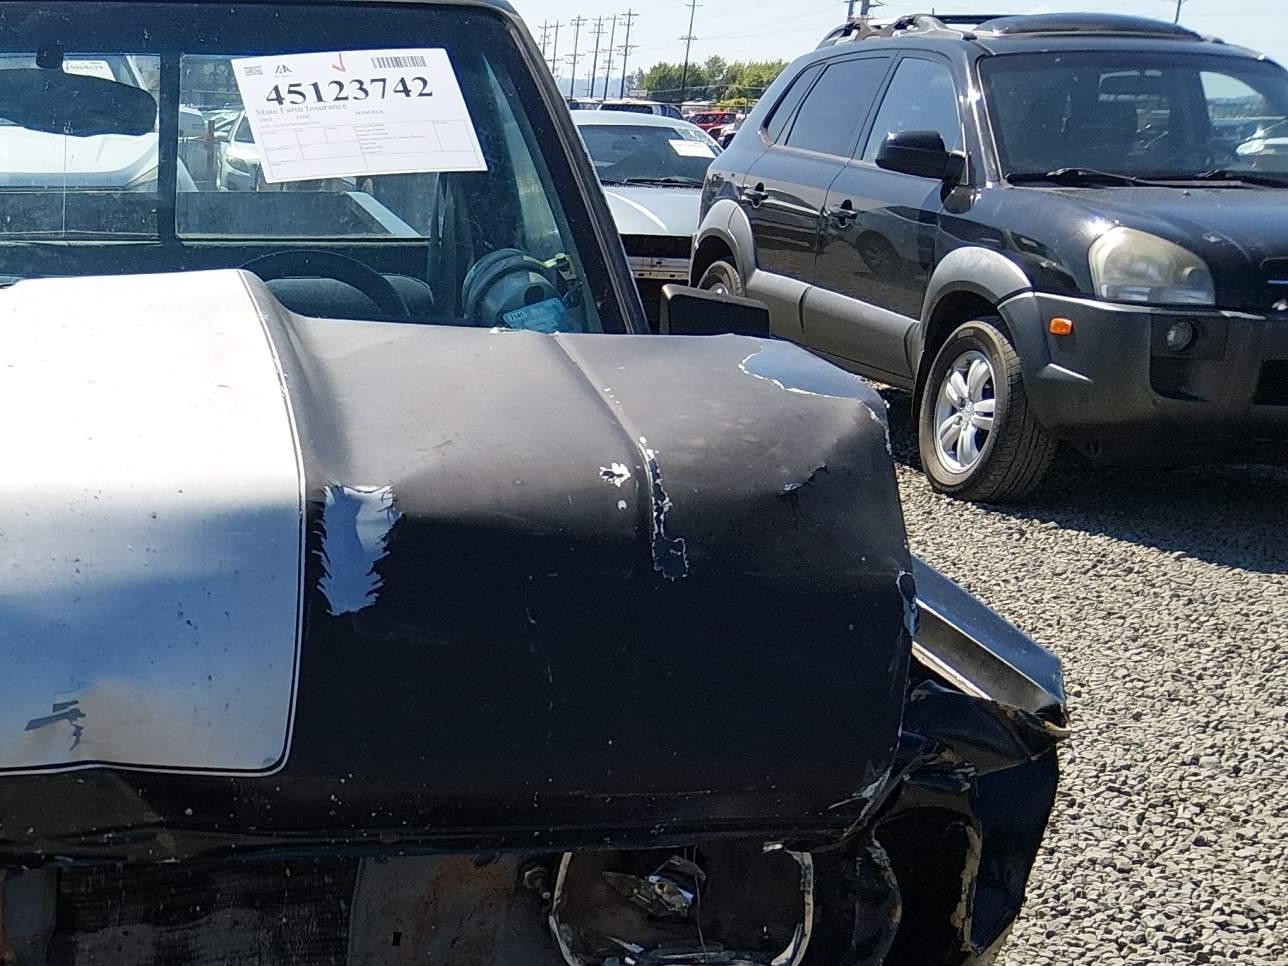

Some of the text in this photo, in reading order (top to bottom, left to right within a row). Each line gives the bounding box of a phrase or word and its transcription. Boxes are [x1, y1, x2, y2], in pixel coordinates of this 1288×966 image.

[265, 76, 433, 106] 45123742
[255, 103, 348, 116] State Farm Insurance
